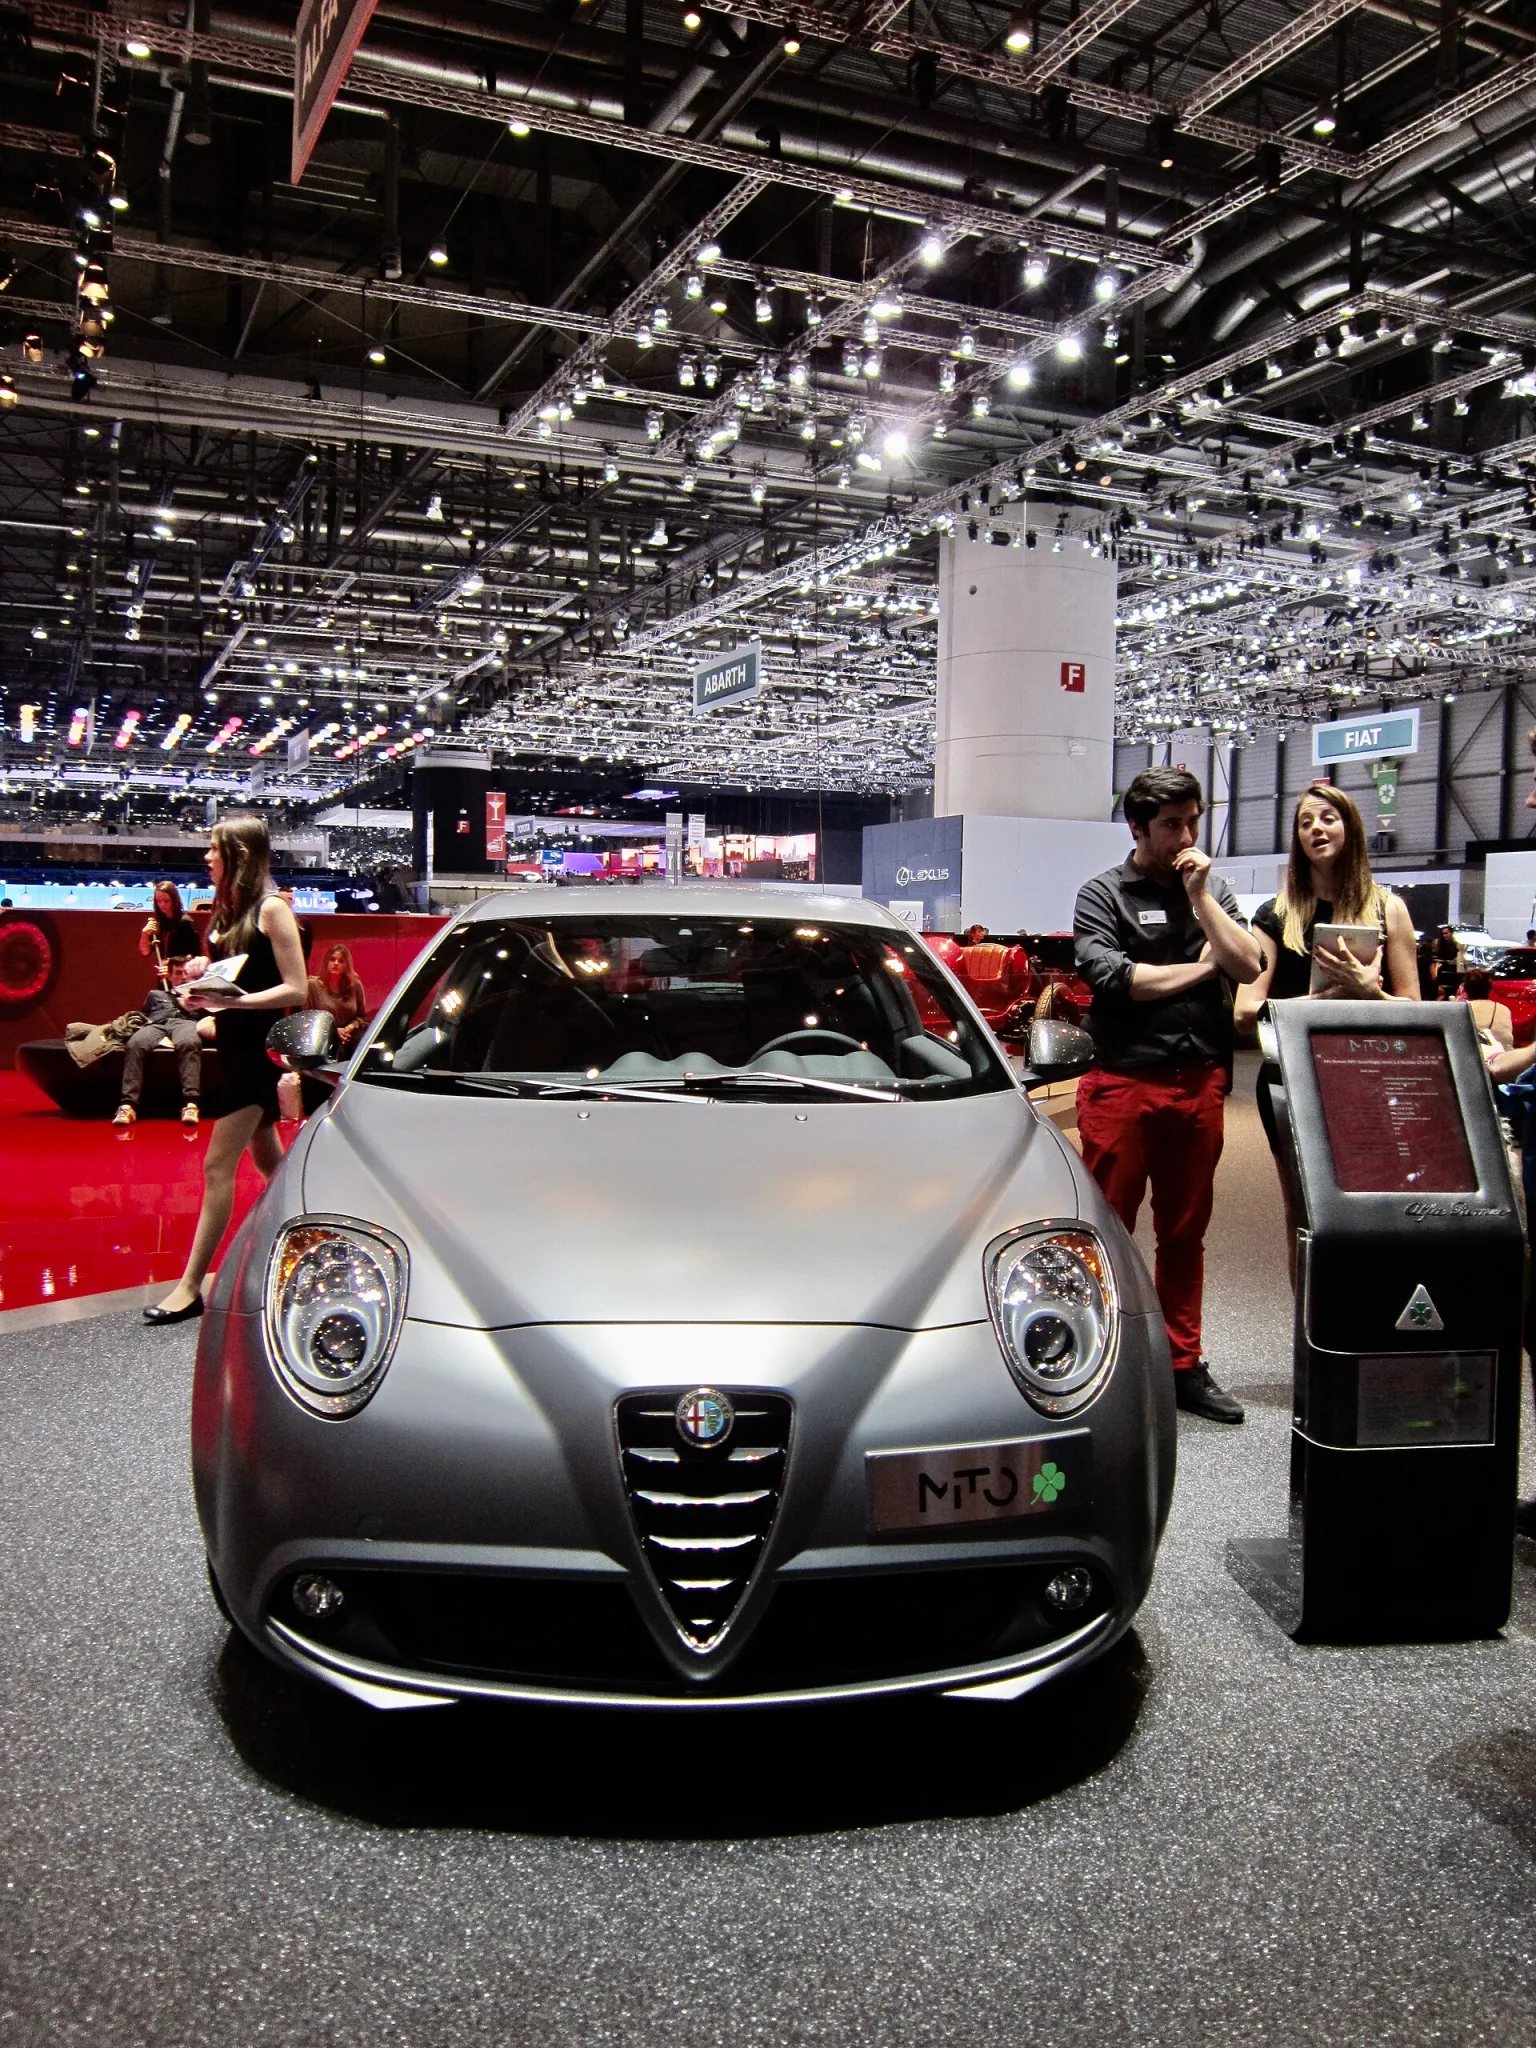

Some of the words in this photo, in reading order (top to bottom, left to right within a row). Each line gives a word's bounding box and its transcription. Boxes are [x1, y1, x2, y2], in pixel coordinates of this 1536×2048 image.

[704, 663, 746, 697] ABARTH
[1068, 665, 1081, 685] F
[1345, 727, 1382, 749] FIAT
[460, 821, 467, 831] F
[910, 868, 949, 881] LEXUS
[1404, 1202, 1446, 1222] Alfa
